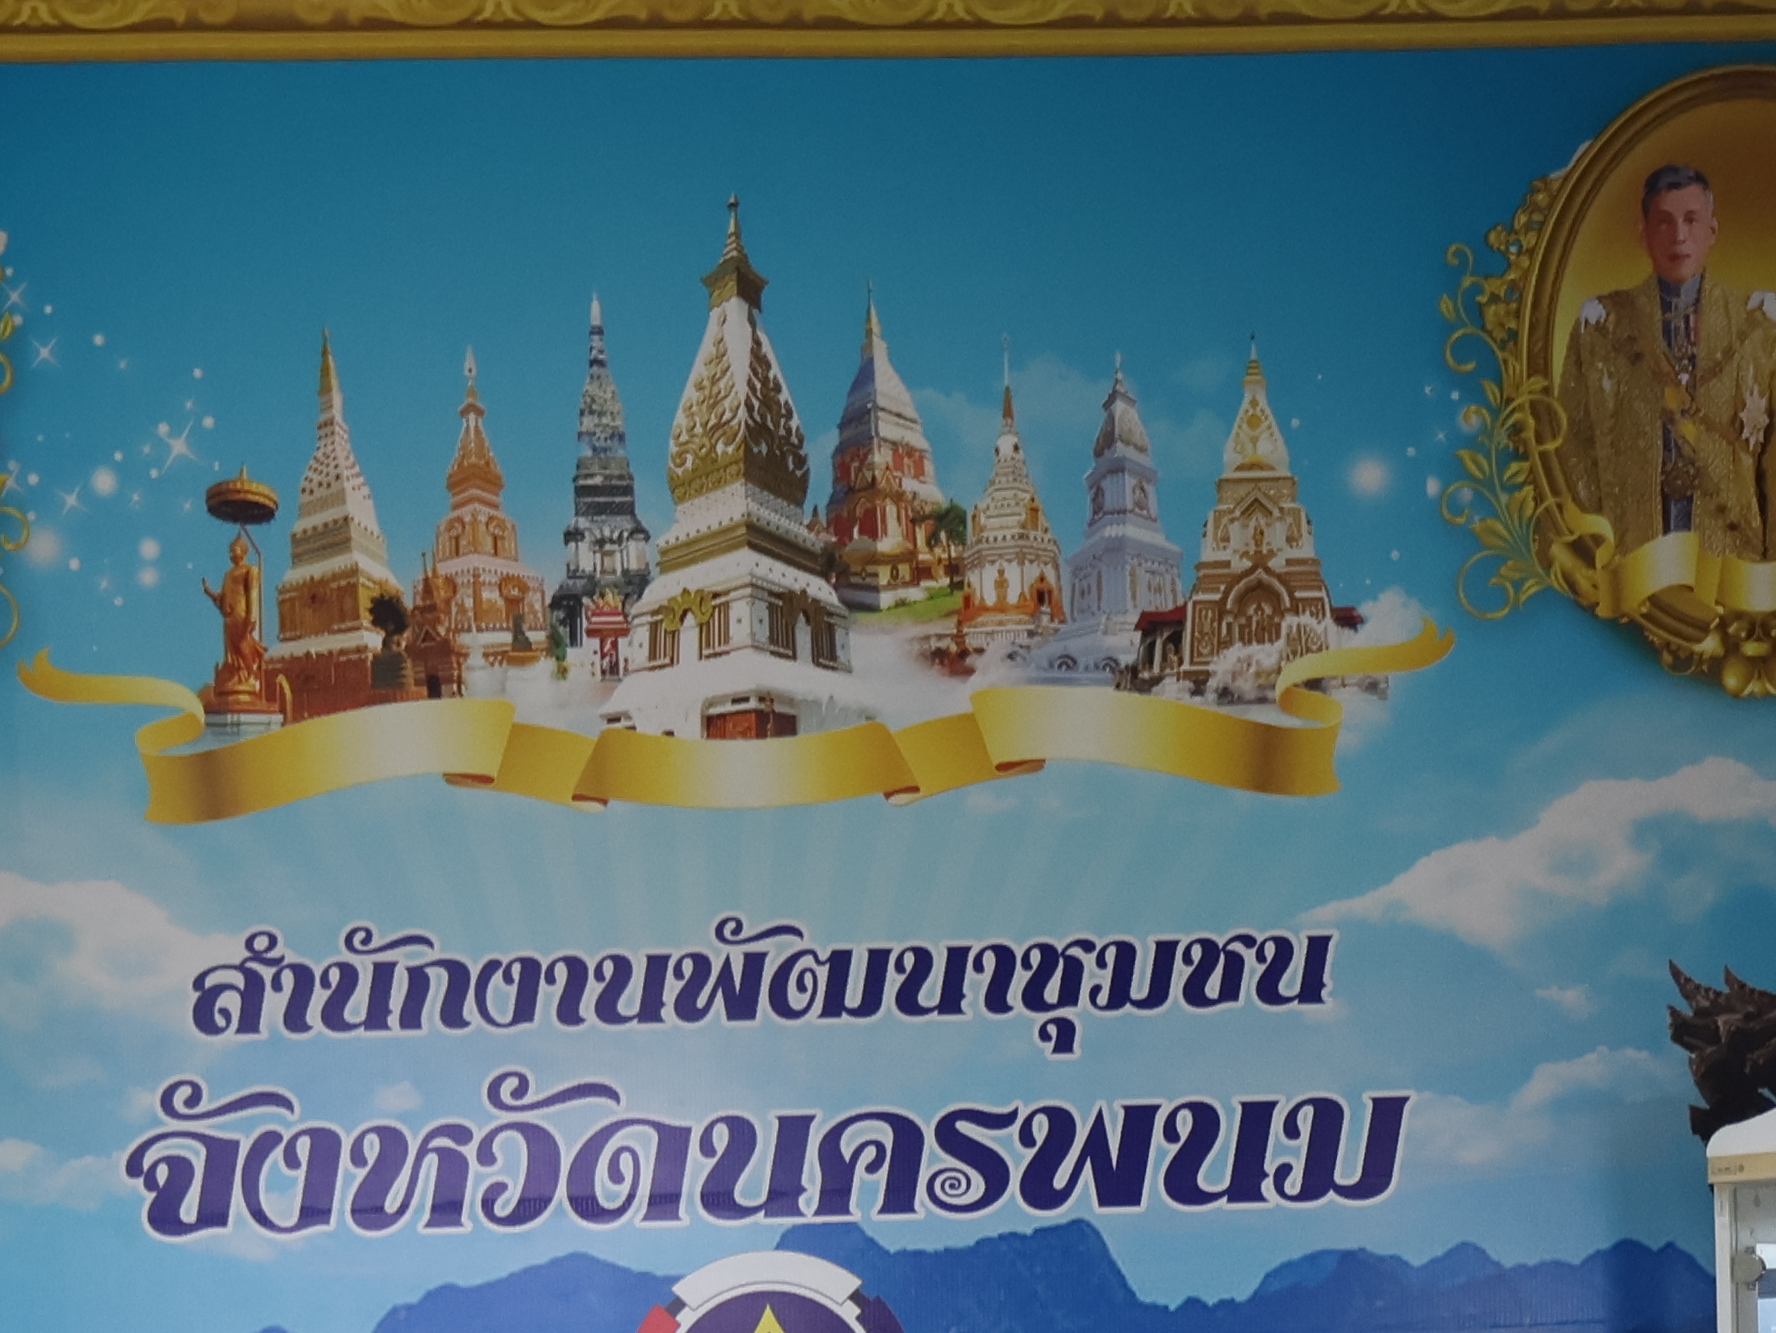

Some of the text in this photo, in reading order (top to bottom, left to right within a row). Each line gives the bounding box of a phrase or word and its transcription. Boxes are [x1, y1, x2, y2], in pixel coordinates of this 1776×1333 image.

[194, 918, 1333, 1056] สำนักงานพัฒนาชุมชน
[125, 1071, 1414, 1234] จังหวัดนครพนม
